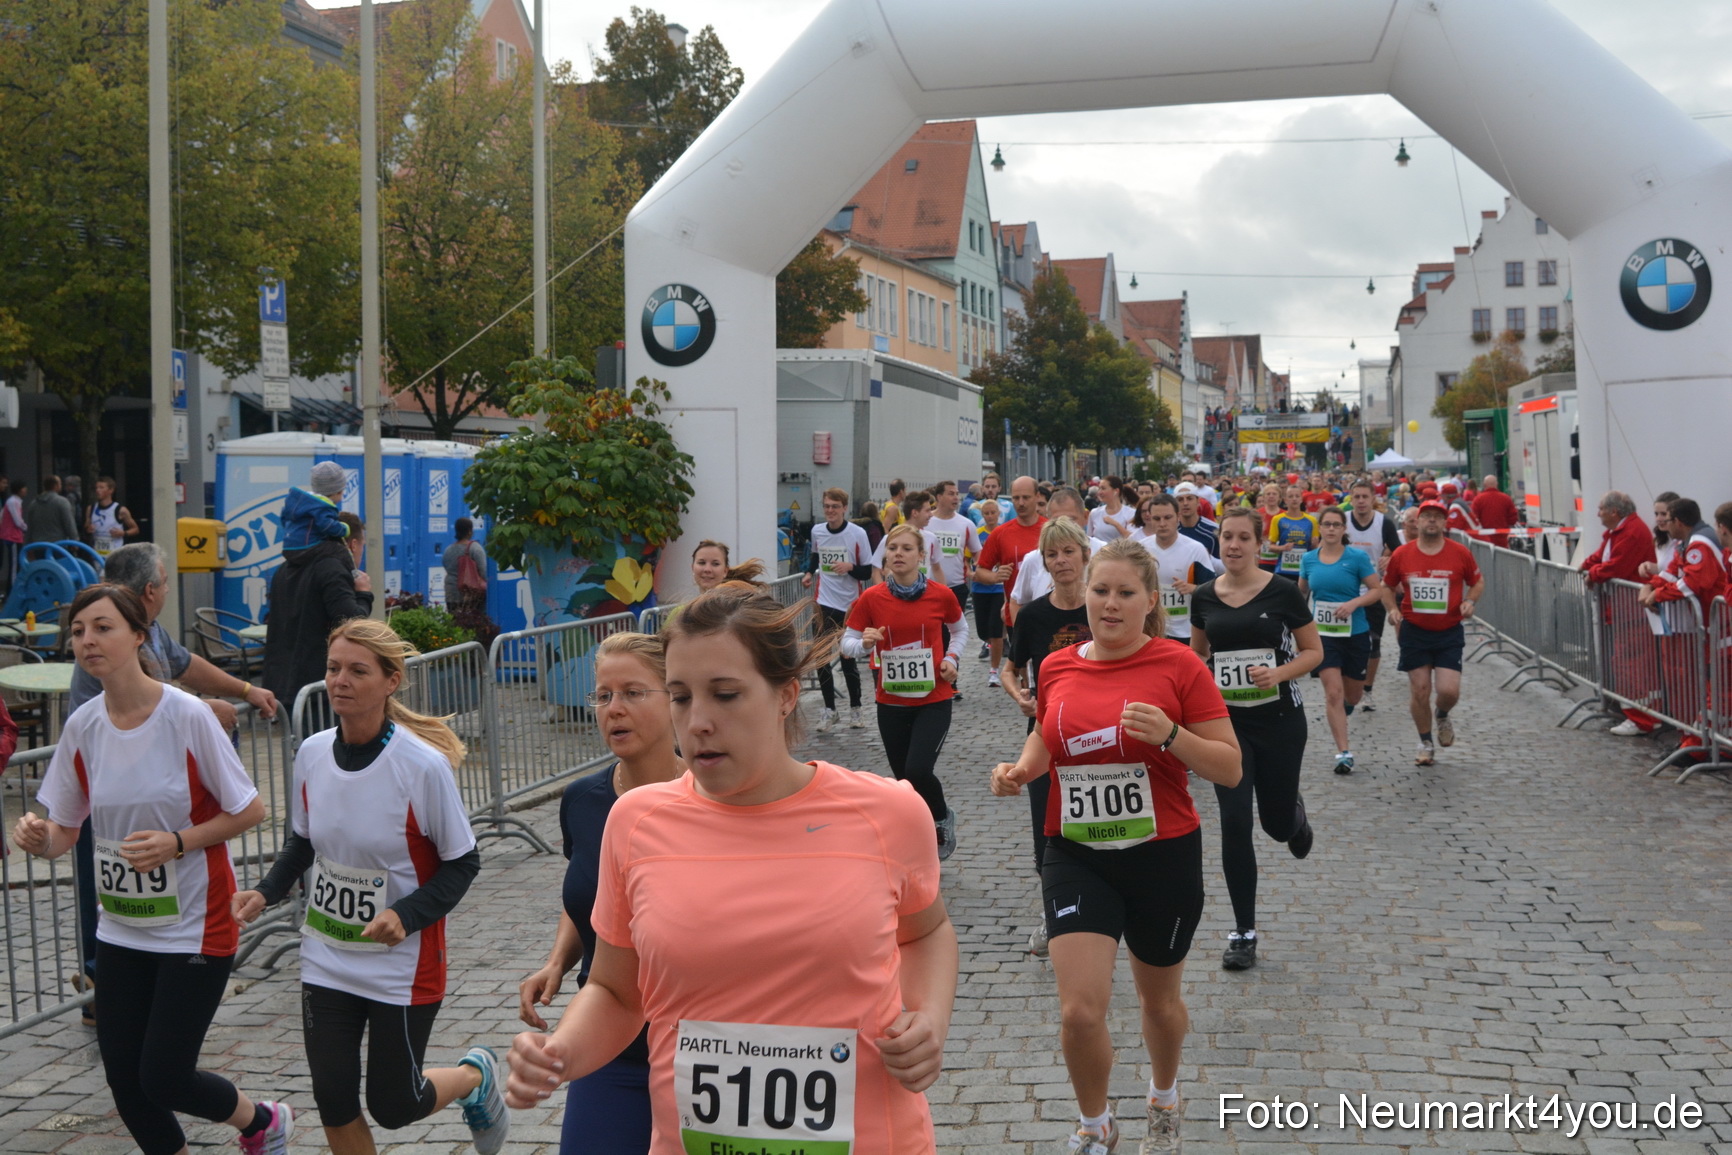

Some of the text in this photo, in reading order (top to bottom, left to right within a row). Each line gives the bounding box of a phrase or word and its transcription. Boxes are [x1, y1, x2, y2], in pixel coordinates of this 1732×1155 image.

[1627, 240, 1704, 272] BMW
[646, 285, 709, 312] BMW
[1267, 431, 1299, 440] START
[822, 553, 845, 564] 5221
[1413, 586, 1443, 600] 5551
[1234, 654, 1264, 662] Neumarkt
[887, 660, 927, 680] 5181
[1232, 690, 1261, 700] Andrea
[1081, 735, 1103, 748] DEHN
[1060, 771, 1131, 782] PARTL Neumarkt
[1069, 782, 1144, 819] 5106
[1087, 826, 1127, 839] Nicole
[96, 845, 114, 857] PARTL
[100, 859, 168, 893] 5219
[329, 868, 369, 886] Neumarkt
[314, 873, 376, 923] 5205
[114, 900, 156, 915] Melanie
[325, 920, 354, 940] Sonja
[680, 1037, 823, 1060] PARTL Neumarkt
[692, 1064, 837, 1131] 5109
